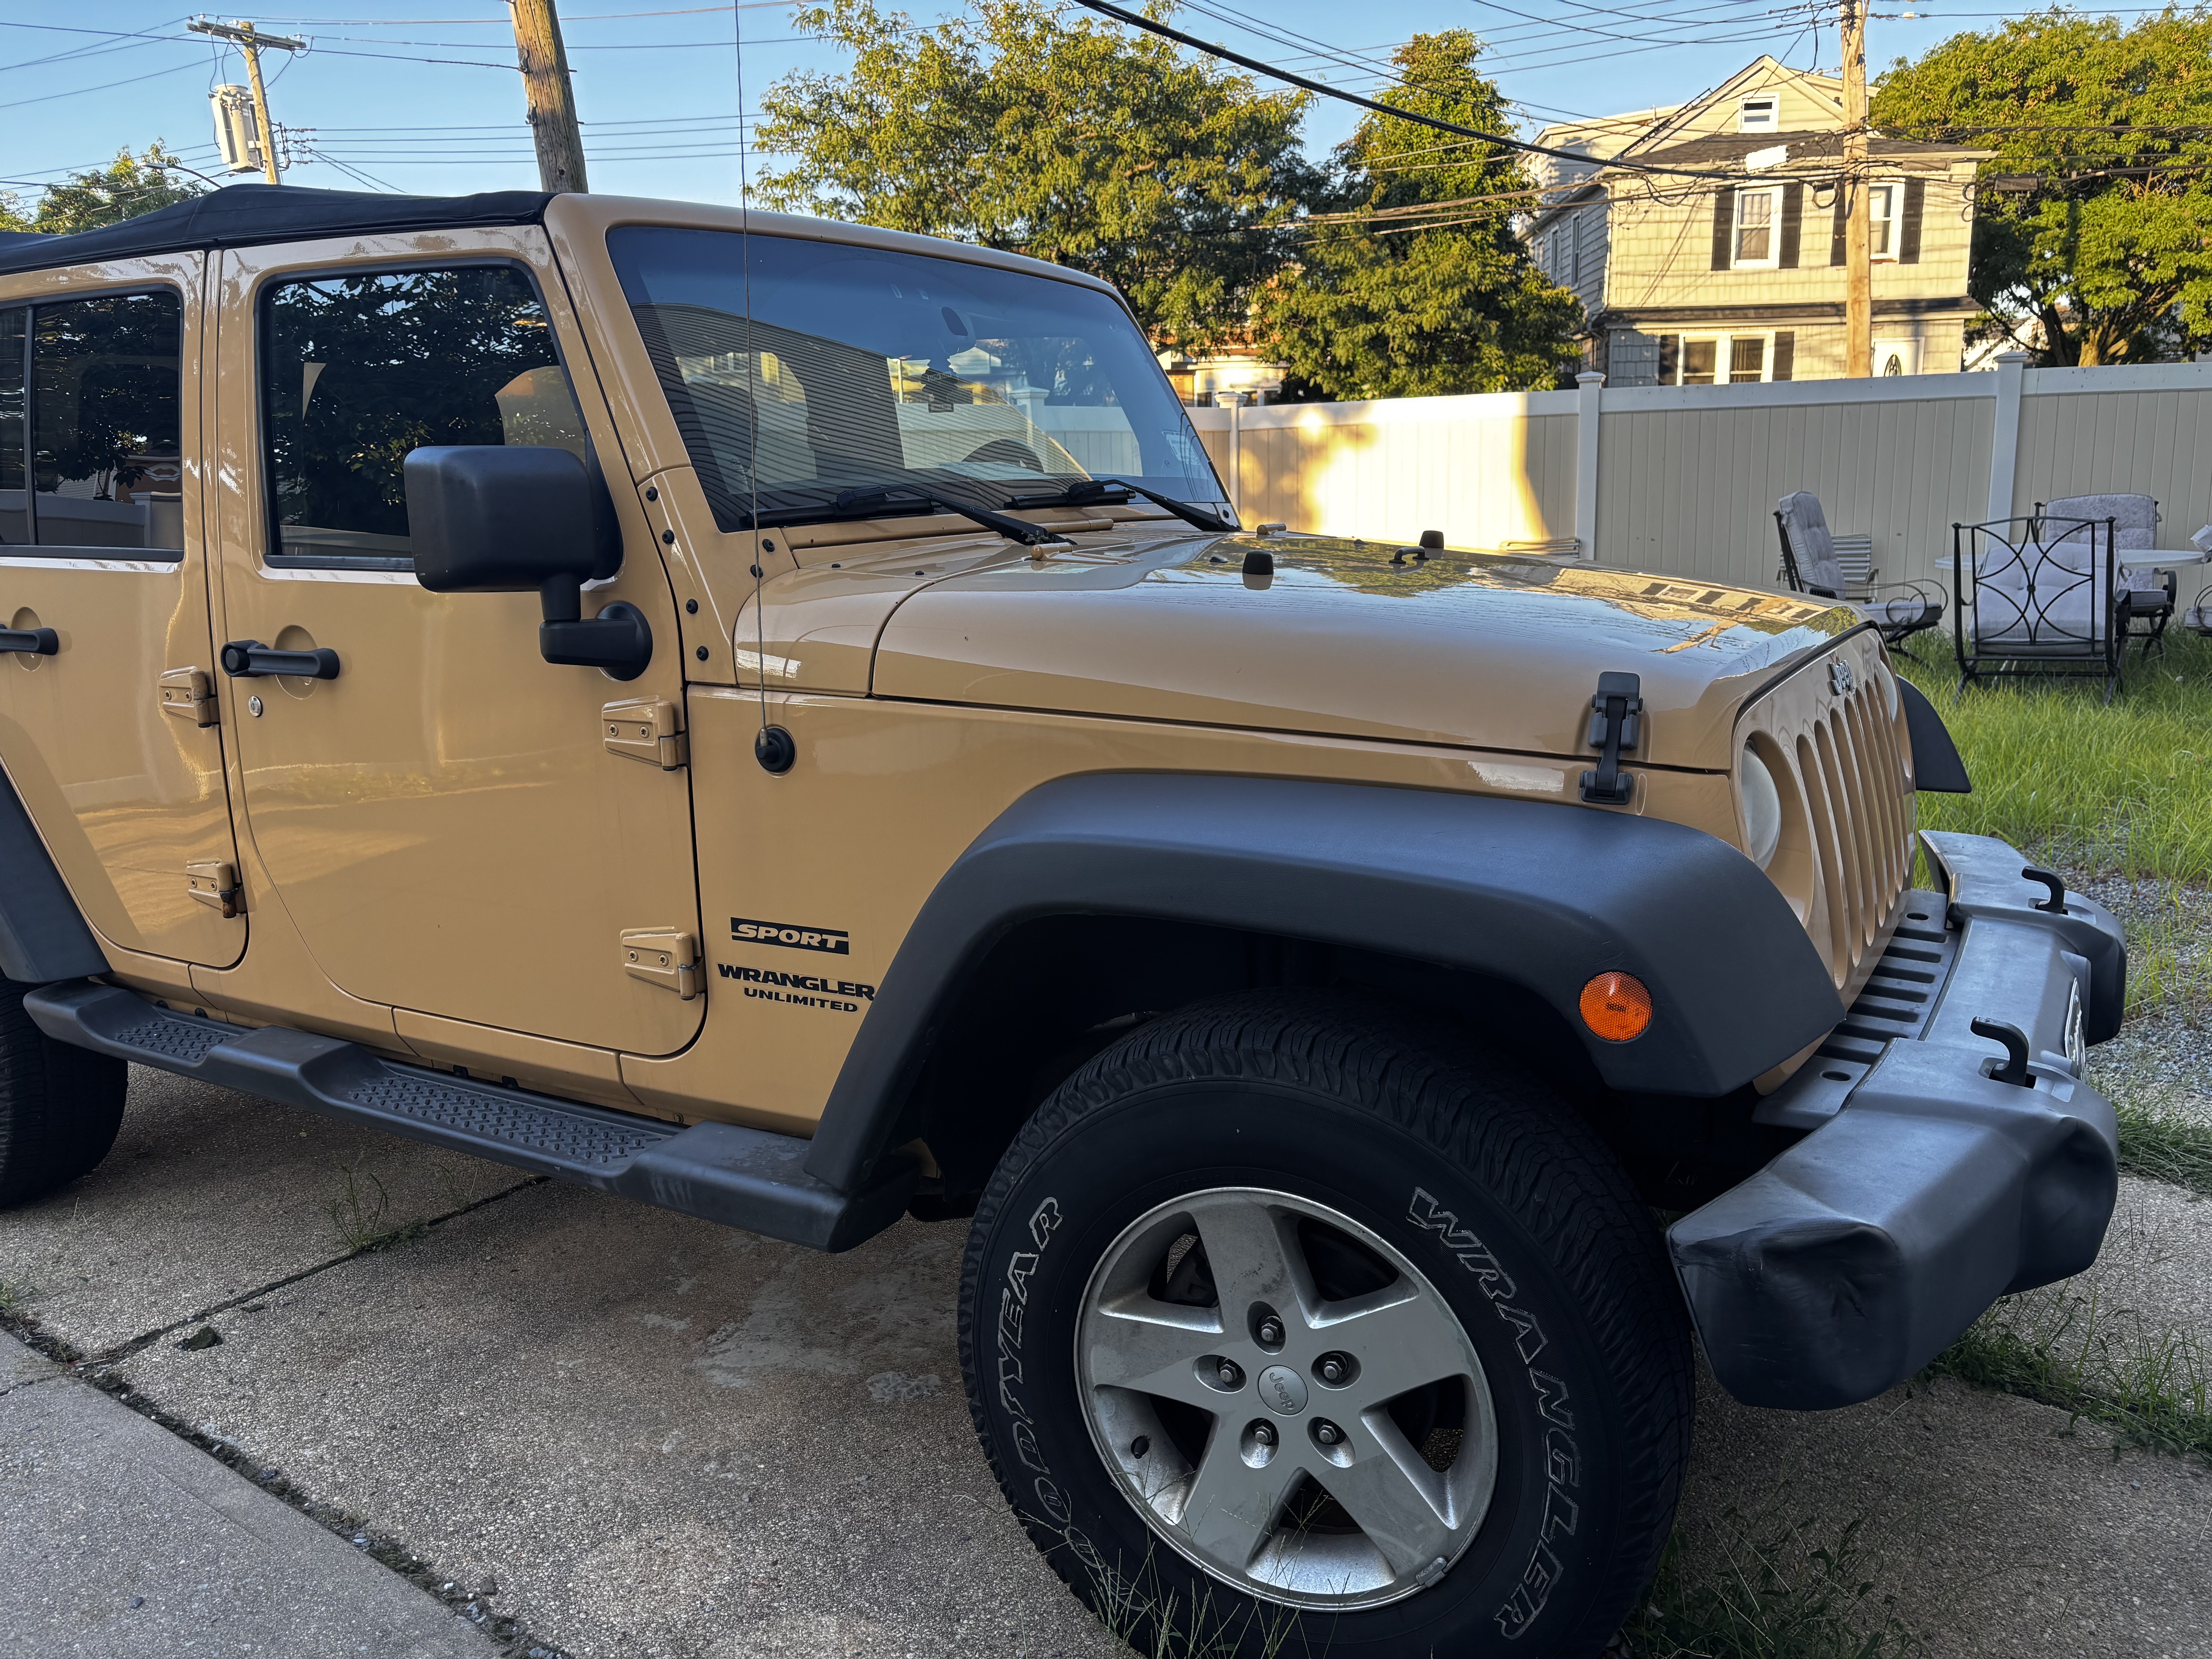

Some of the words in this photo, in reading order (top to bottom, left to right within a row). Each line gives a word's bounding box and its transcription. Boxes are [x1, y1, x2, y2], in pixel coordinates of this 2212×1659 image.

[1826, 659, 1855, 696] Jeep
[732, 924, 849, 949] SPORT
[717, 963, 875, 1001] WRANGLER
[744, 987, 858, 1012] UNLIMITED
[998, 1196, 1149, 1611] GOODYEAR
[1269, 1372, 1295, 1410] Jeep
[1405, 1186, 1581, 1640] WRANGLER
